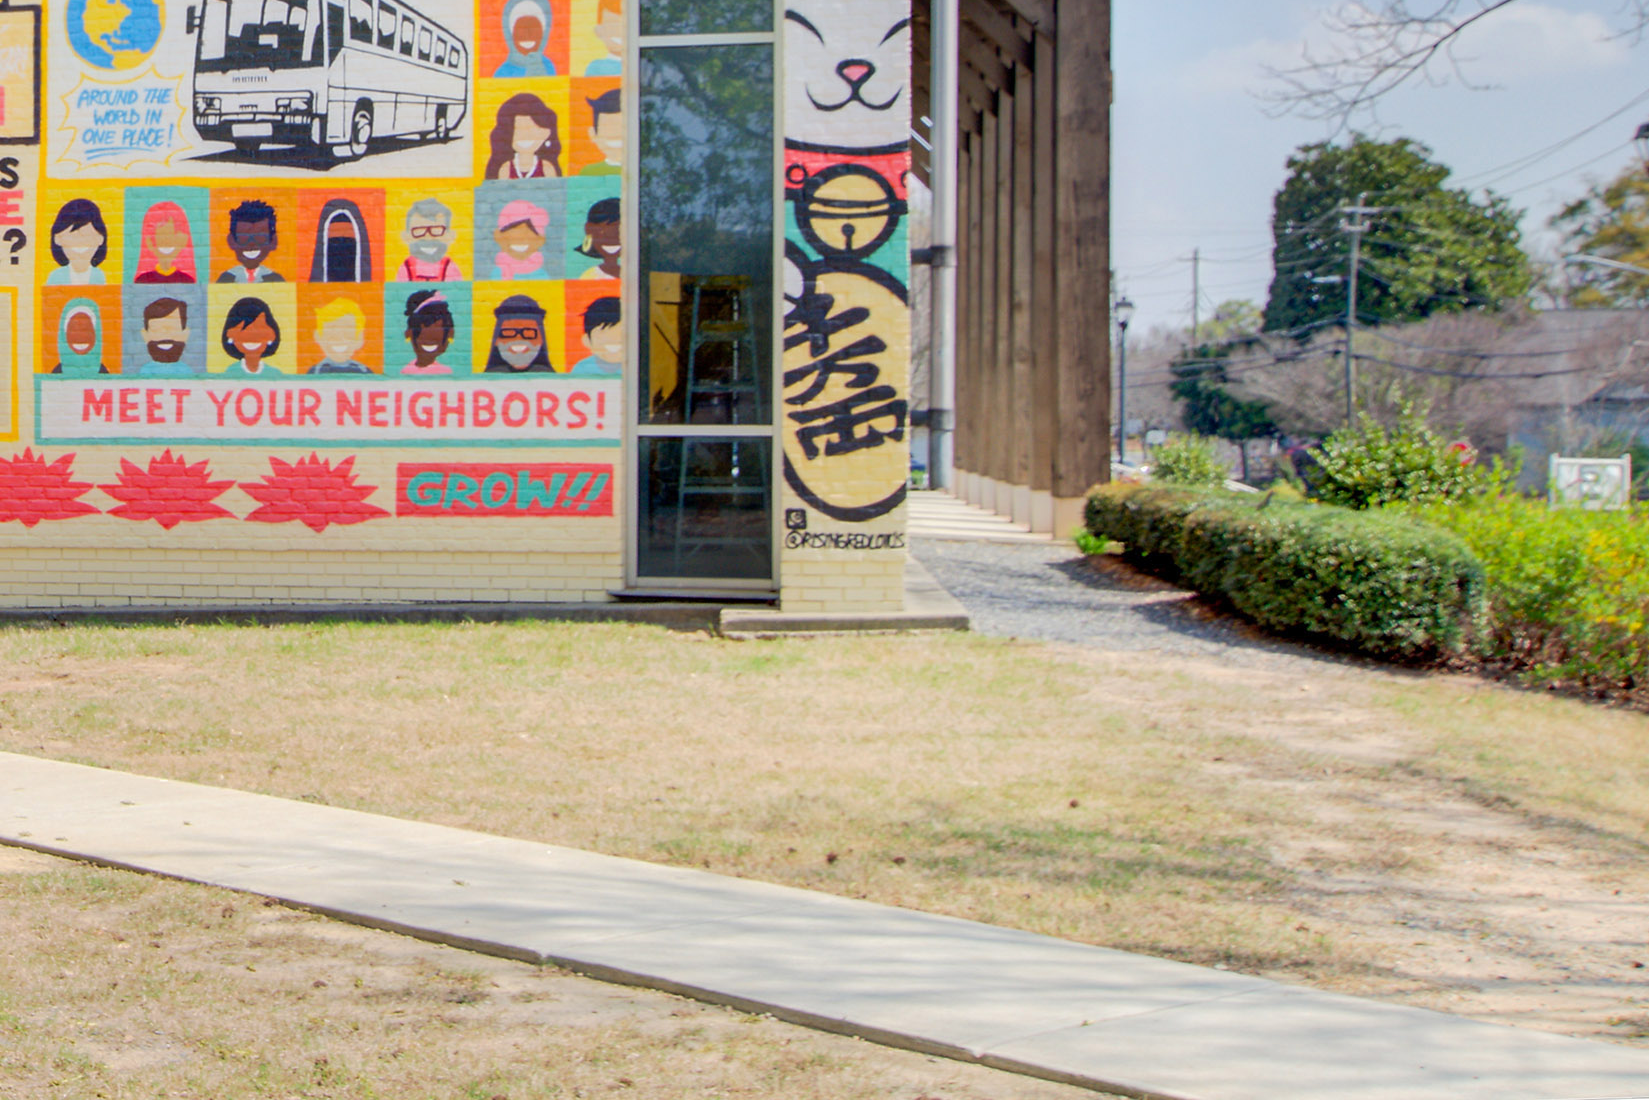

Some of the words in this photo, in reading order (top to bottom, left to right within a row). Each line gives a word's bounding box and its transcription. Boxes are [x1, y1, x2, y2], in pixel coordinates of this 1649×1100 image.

[77, 89, 139, 108] AROUND
[144, 87, 173, 104] THE
[93, 108, 140, 126] WORLD
[145, 108, 162, 125] IN
[82, 128, 116, 145] ONE
[81, 387, 192, 424] MEET
[205, 387, 323, 428] YOUR
[335, 389, 607, 432] NEIGHBORS!
[405, 470, 610, 512] GROW!!
